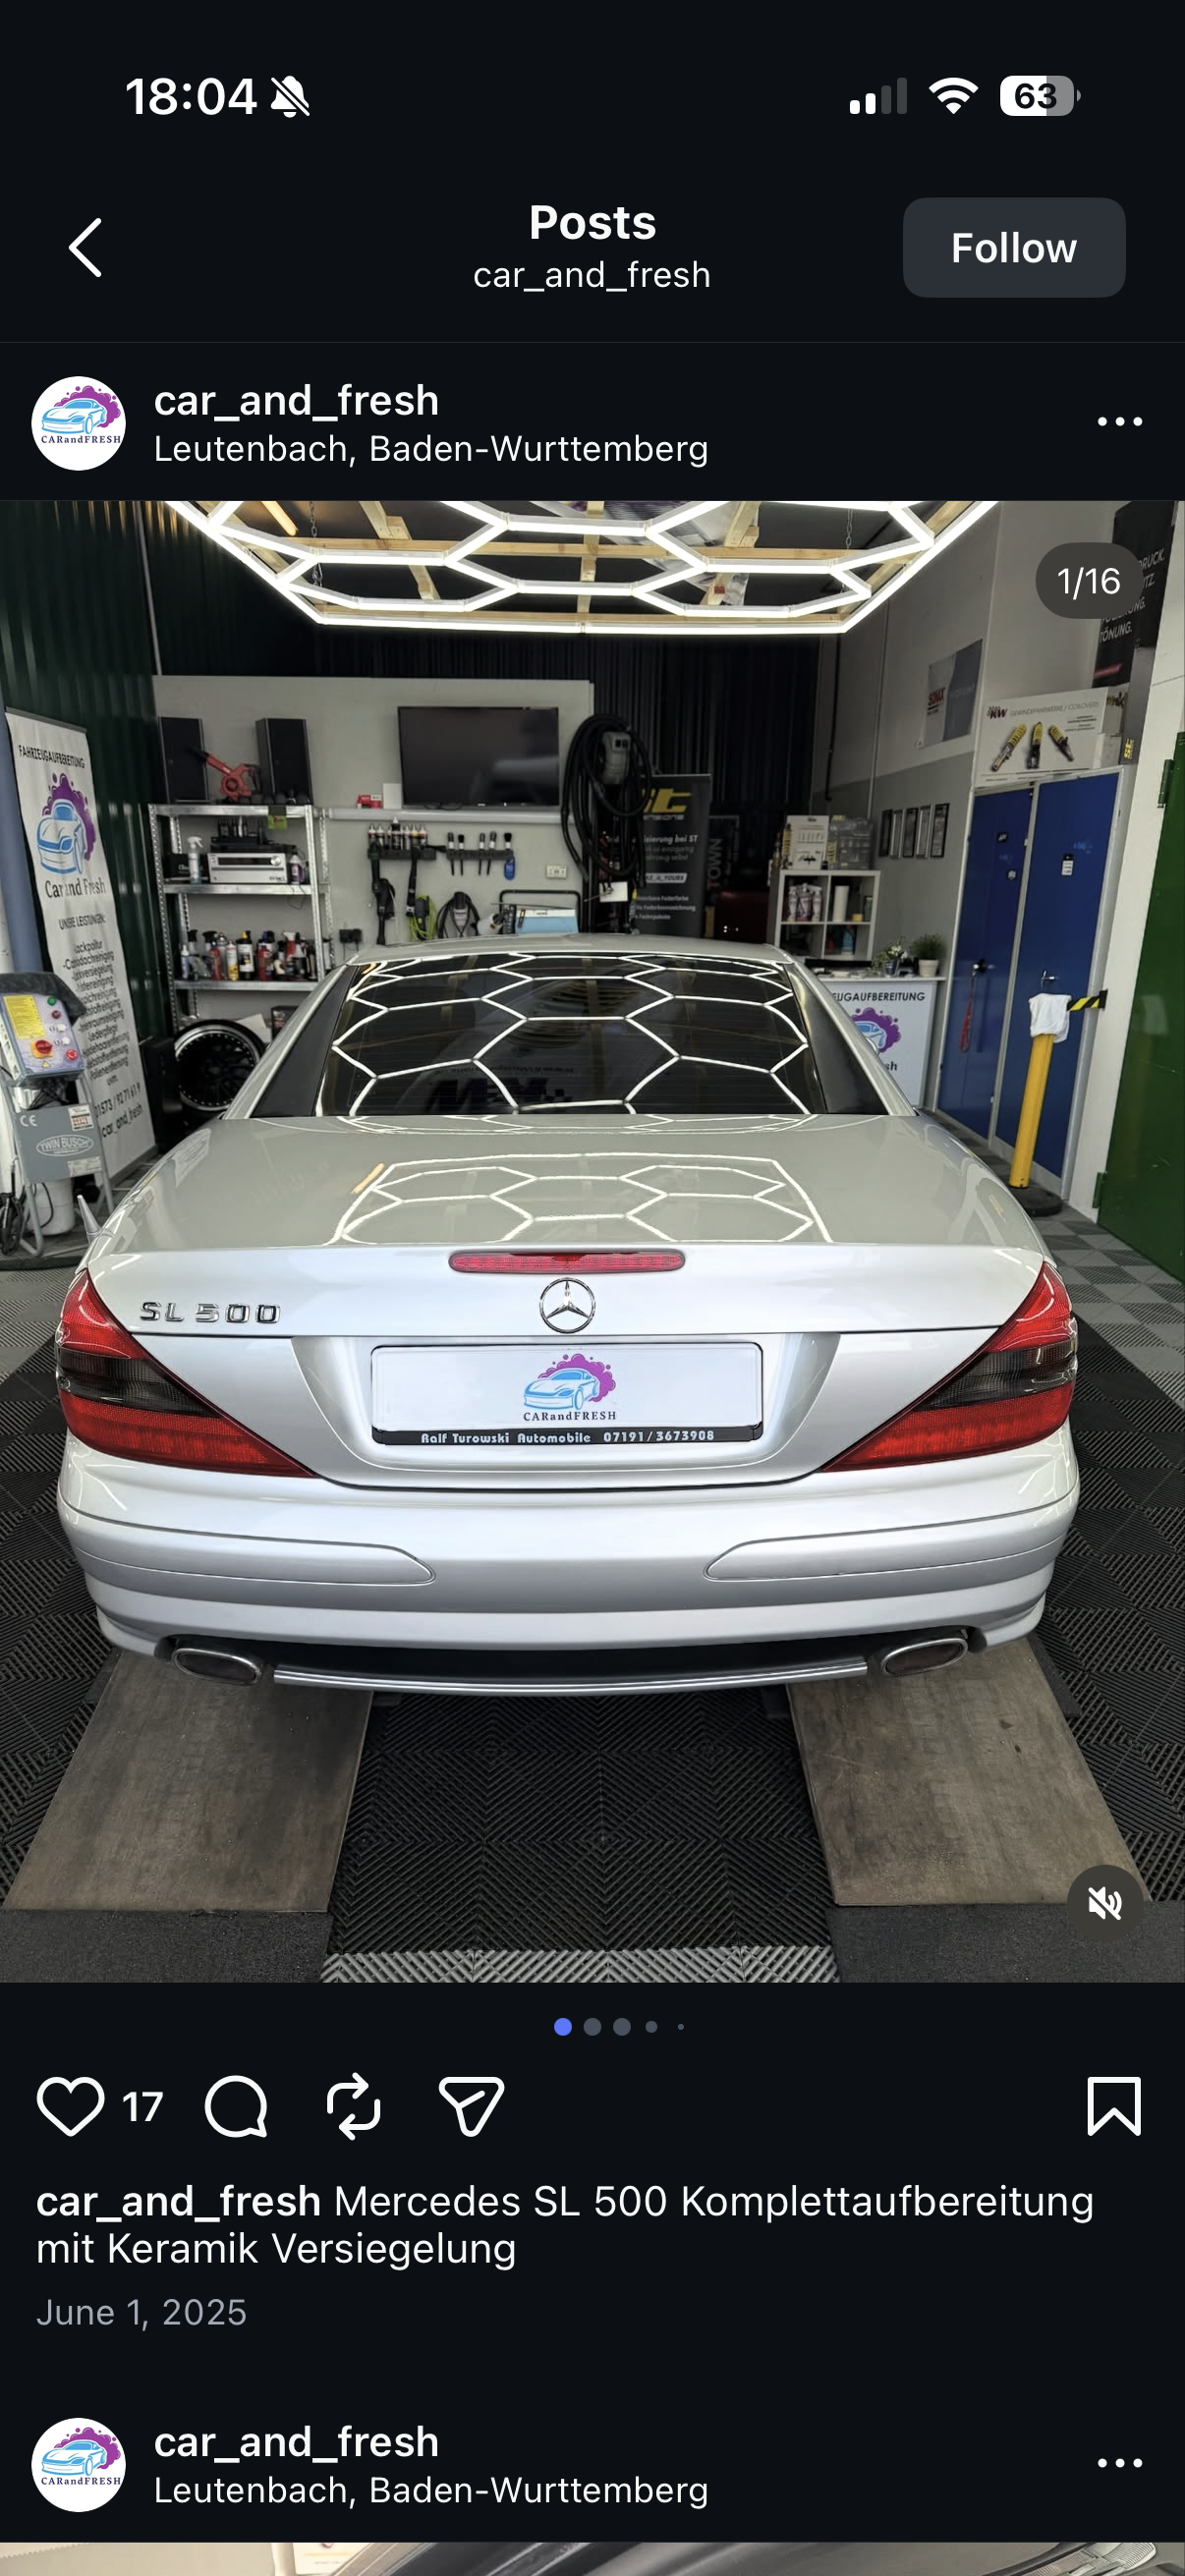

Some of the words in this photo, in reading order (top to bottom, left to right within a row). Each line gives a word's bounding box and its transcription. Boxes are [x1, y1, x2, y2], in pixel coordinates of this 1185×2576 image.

[45, 880, 63, 899] Car
[140, 1302, 185, 1322] SL
[195, 1303, 281, 1324] 500
[523, 1412, 616, 1422] CARandFRESH
[421, 1432, 447, 1444] Ralf
[452, 1431, 510, 1444] Turowski
[517, 1431, 592, 1444] Automobile
